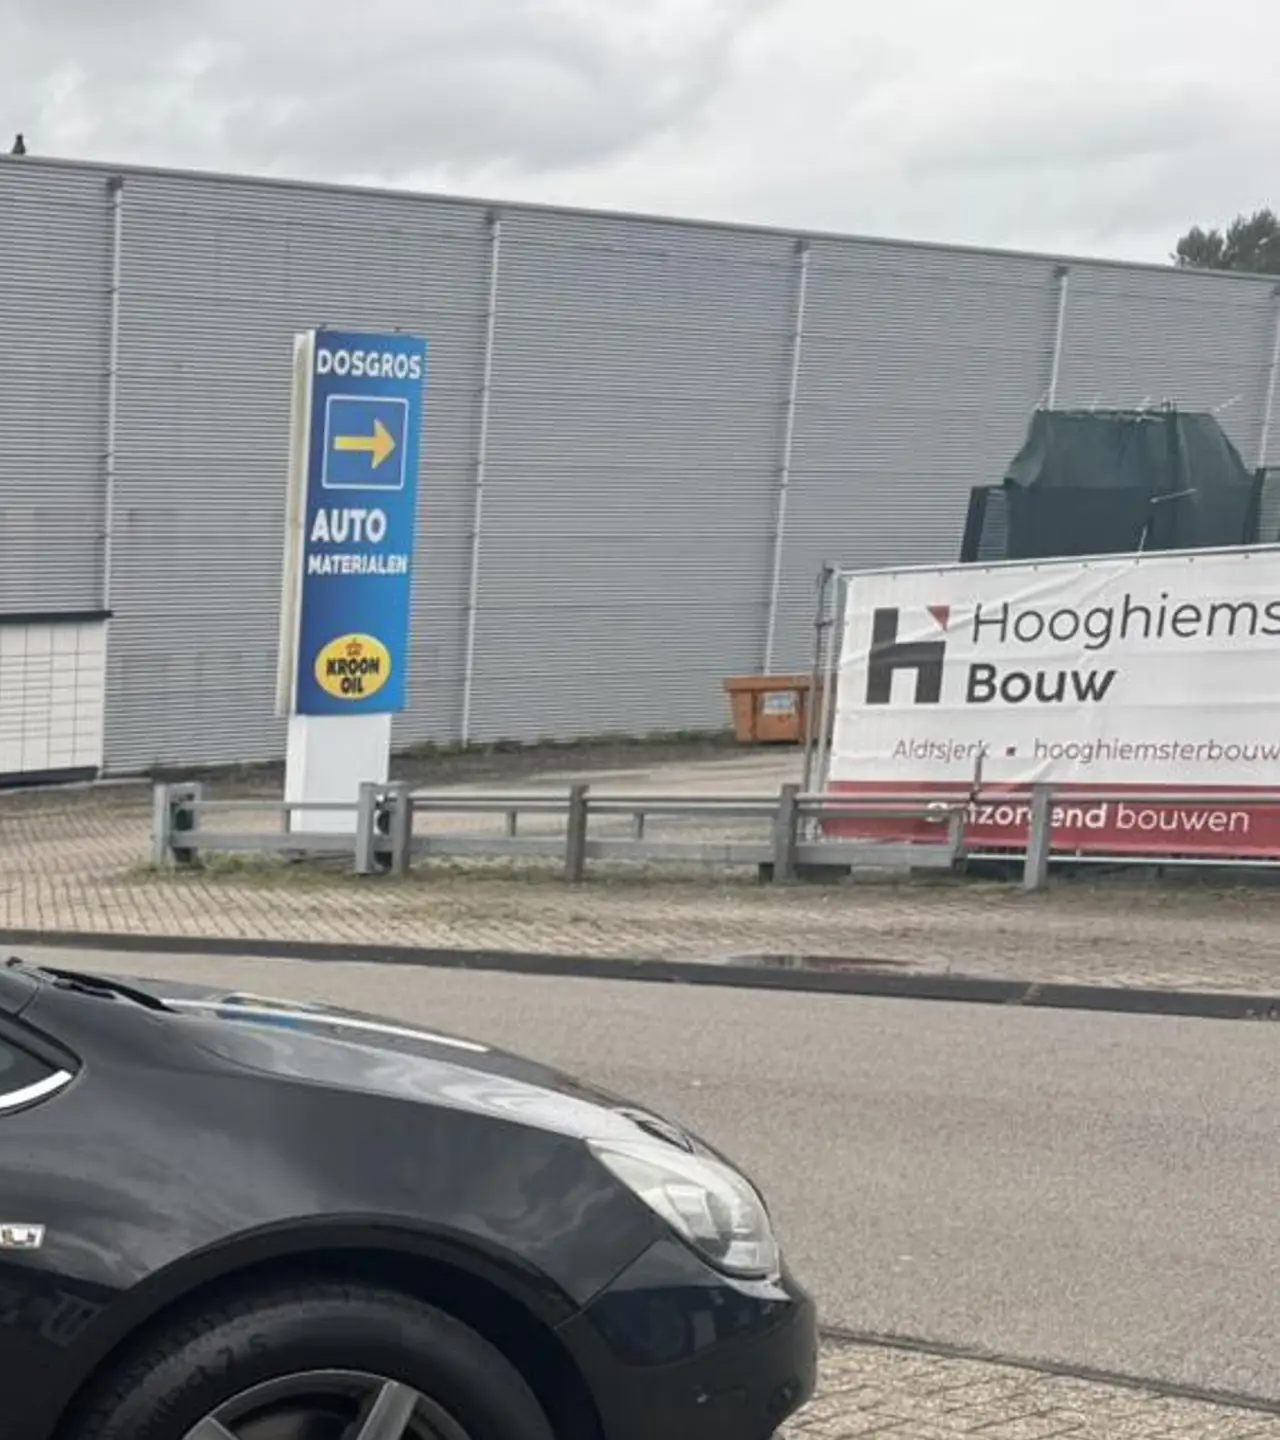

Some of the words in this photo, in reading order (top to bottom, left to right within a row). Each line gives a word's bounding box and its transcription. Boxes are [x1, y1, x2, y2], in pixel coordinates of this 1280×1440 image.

[316, 348, 422, 380] DOSGROS
[310, 508, 387, 543] AUTO
[307, 552, 409, 575] MATERIALEN
[972, 593, 1280, 650] Hooghiems
[326, 657, 380, 676] KROON
[341, 677, 364, 693] OIL
[965, 663, 1118, 703] Bouw
[1116, 803, 1250, 832] bouwen
